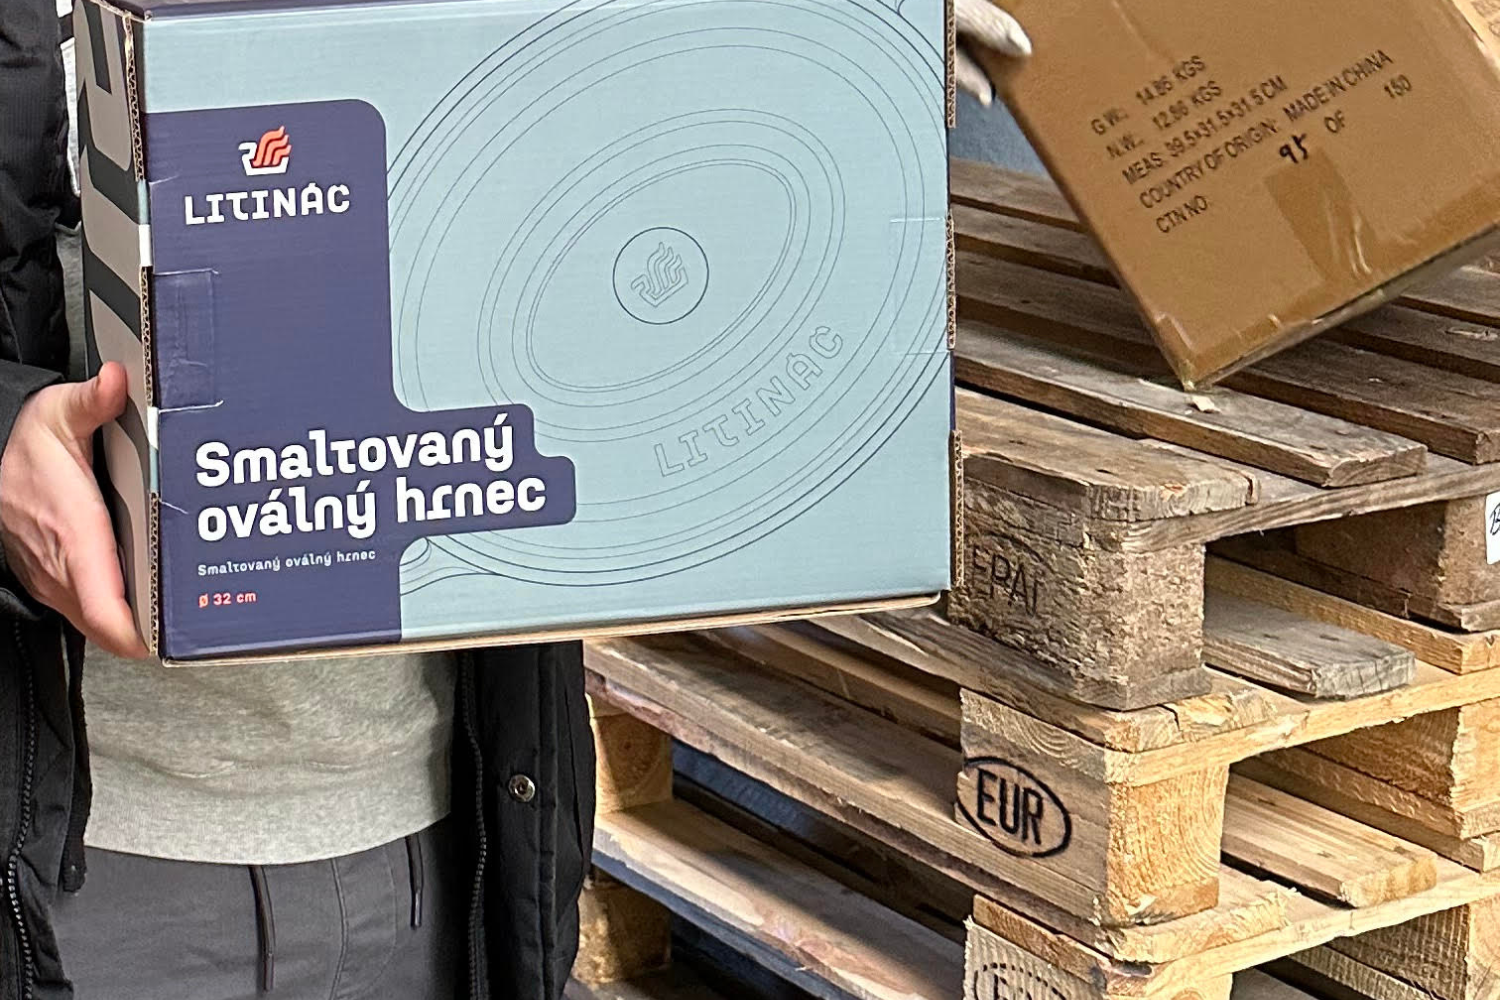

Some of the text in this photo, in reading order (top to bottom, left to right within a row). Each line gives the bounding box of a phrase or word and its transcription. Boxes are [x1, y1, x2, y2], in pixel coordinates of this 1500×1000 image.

[1173, 55, 1206, 82] KGS
[1191, 80, 1223, 107] KGS
[1139, 160, 1204, 209] COUNTRY
[1204, 148, 1225, 171] OF
[1283, 85, 1330, 122] MADE
[1326, 76, 1347, 98] IN
[1342, 49, 1394, 87] CHINA
[1324, 109, 1346, 134] OF
[184, 182, 350, 226] LITINÁC
[1155, 208, 1188, 234] CTN
[195, 413, 514, 488] Smaltovaný
[197, 476, 546, 542] oválný hrnec
[198, 548, 376, 577] Smaltovaný oválný hrnec
[213, 592, 232, 607] 32
[236, 591, 257, 604] cm
[977, 767, 1044, 845] EUR
